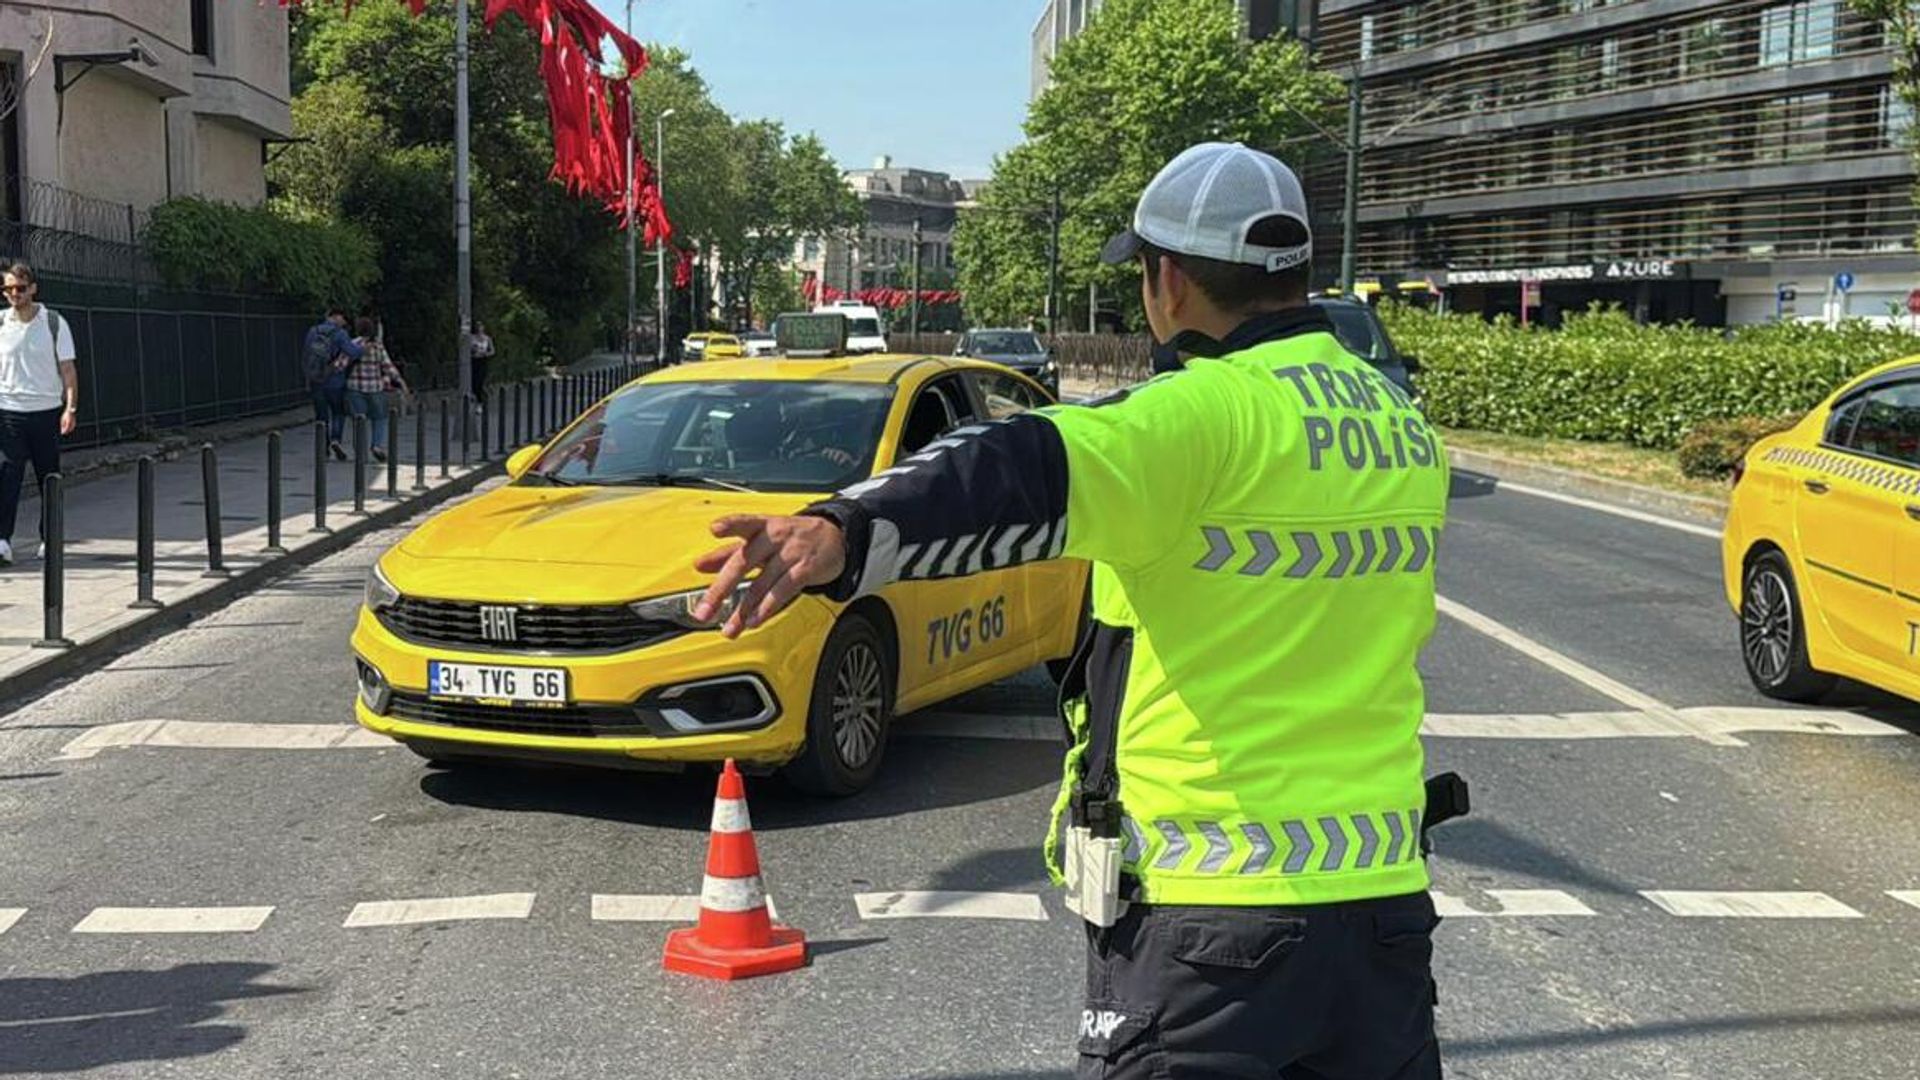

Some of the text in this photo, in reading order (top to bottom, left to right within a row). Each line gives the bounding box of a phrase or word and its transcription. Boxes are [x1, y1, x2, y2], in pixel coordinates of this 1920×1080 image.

[1606, 261, 1674, 276] AZURE
[480, 606, 518, 641] FIAT
[928, 595, 1005, 665] TVG 66
[440, 666, 560, 698] 34 TVG 66
